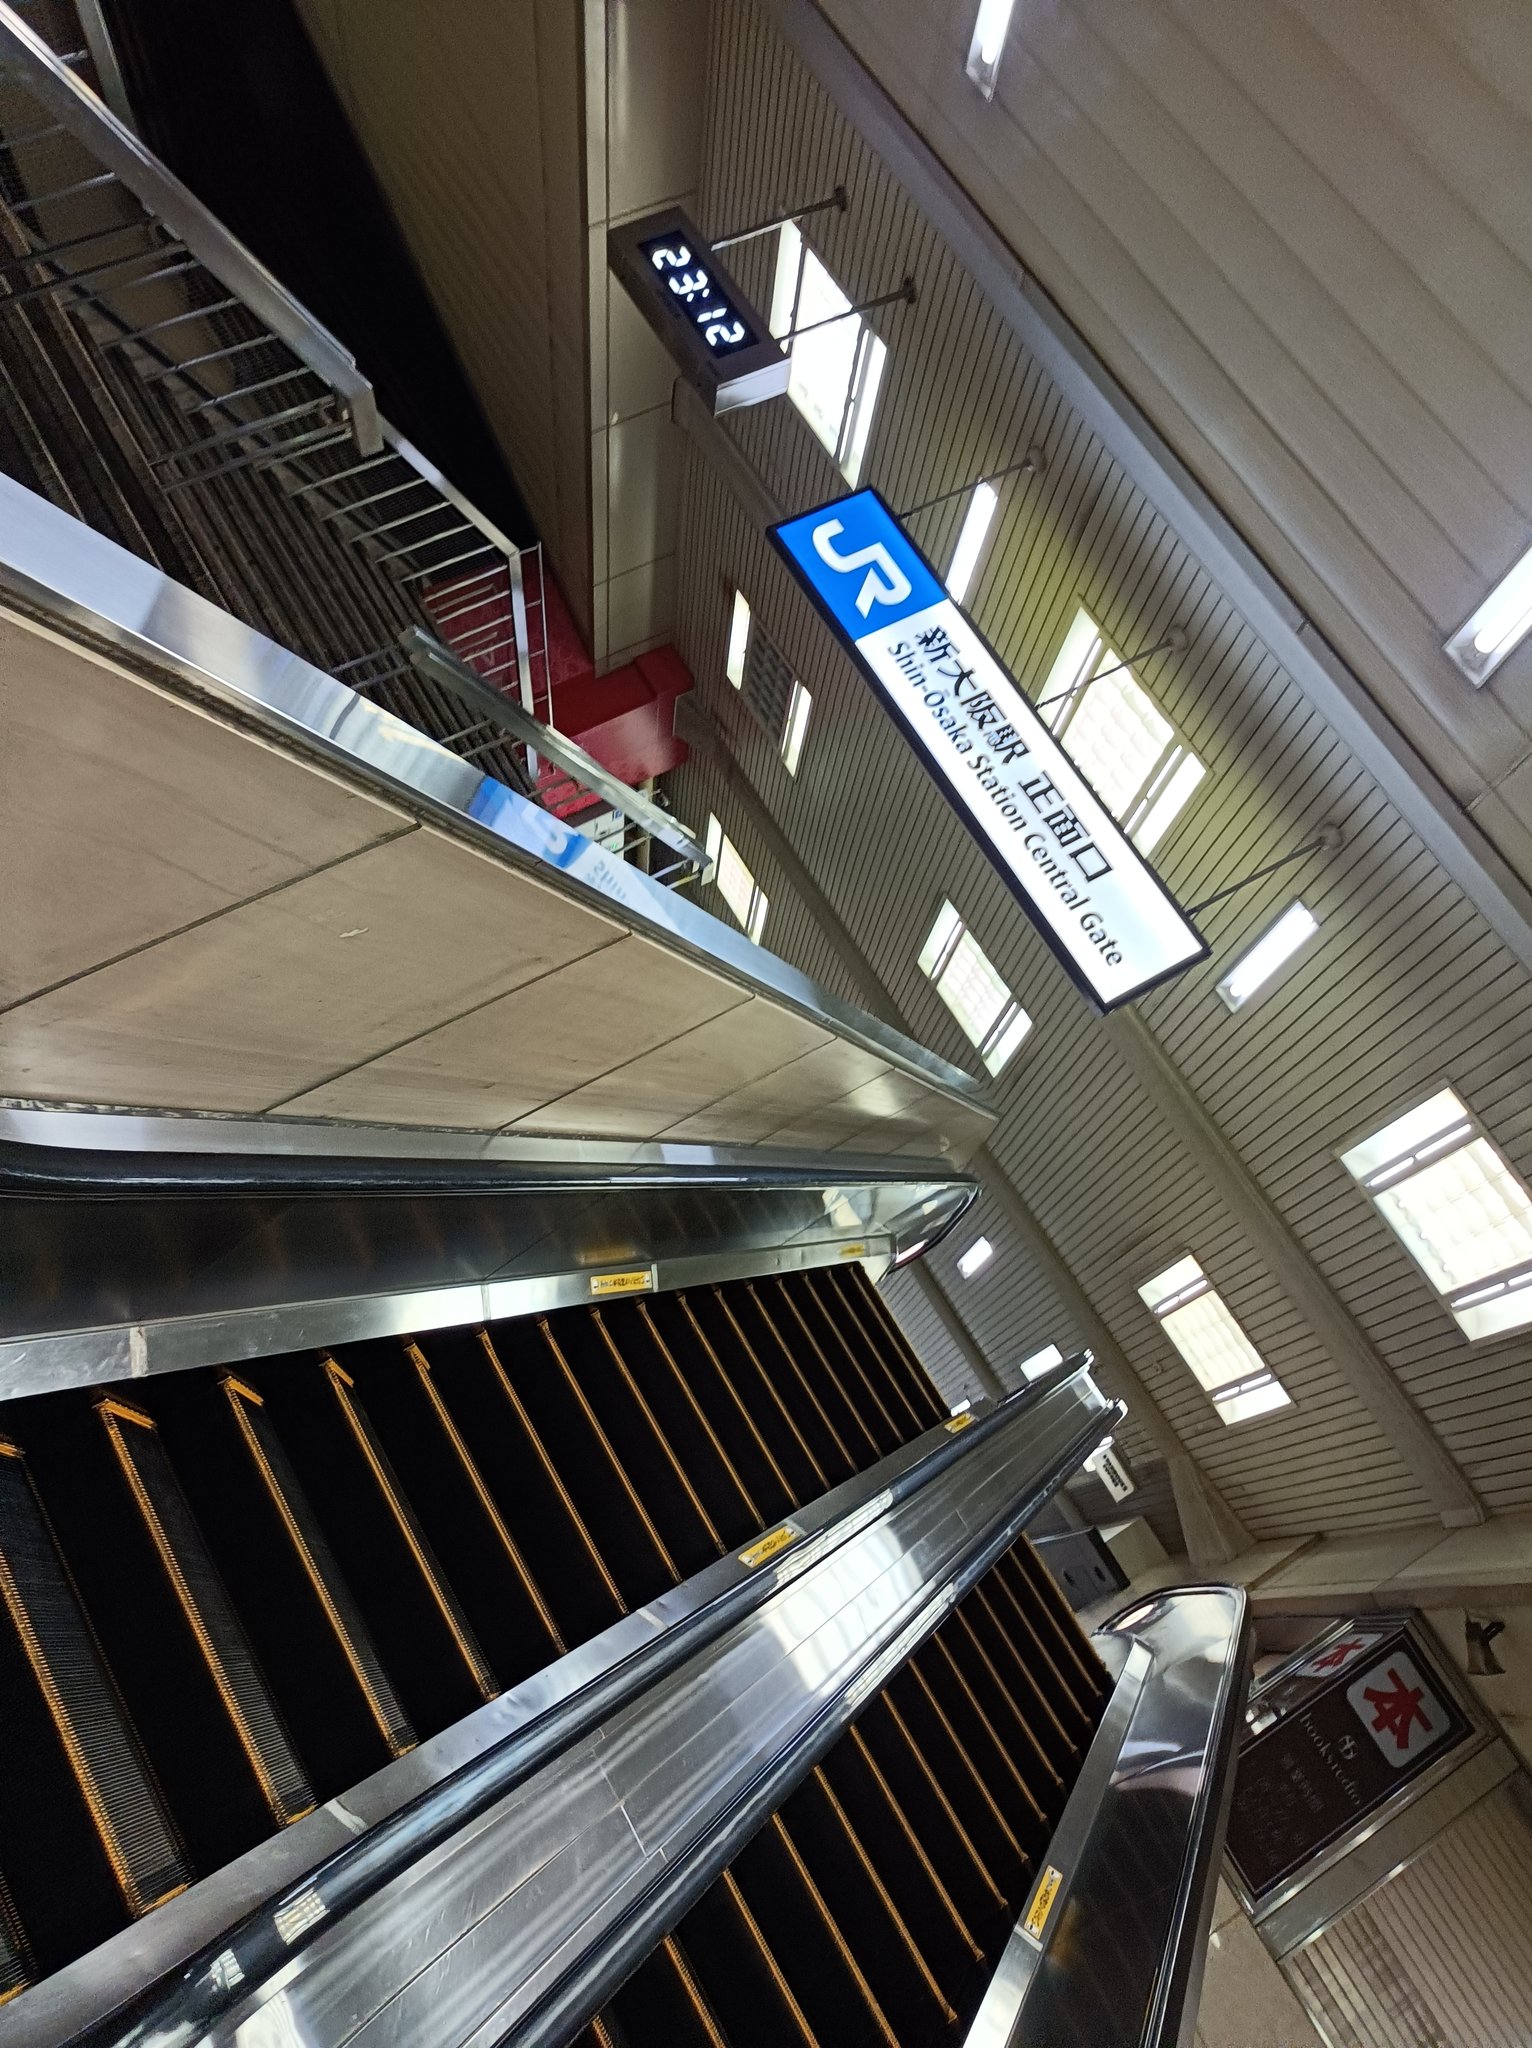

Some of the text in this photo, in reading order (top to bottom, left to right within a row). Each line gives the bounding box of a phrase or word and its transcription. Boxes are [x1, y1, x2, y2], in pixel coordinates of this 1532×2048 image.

[652, 245, 745, 346] 23:12
[812, 518, 912, 619] JR
[888, 641, 1123, 967] Shin-Ōsaka Station Central Gate
[915, 625, 1114, 883] 新大阪駅 正面口
[1363, 1668, 1433, 1749] 本
